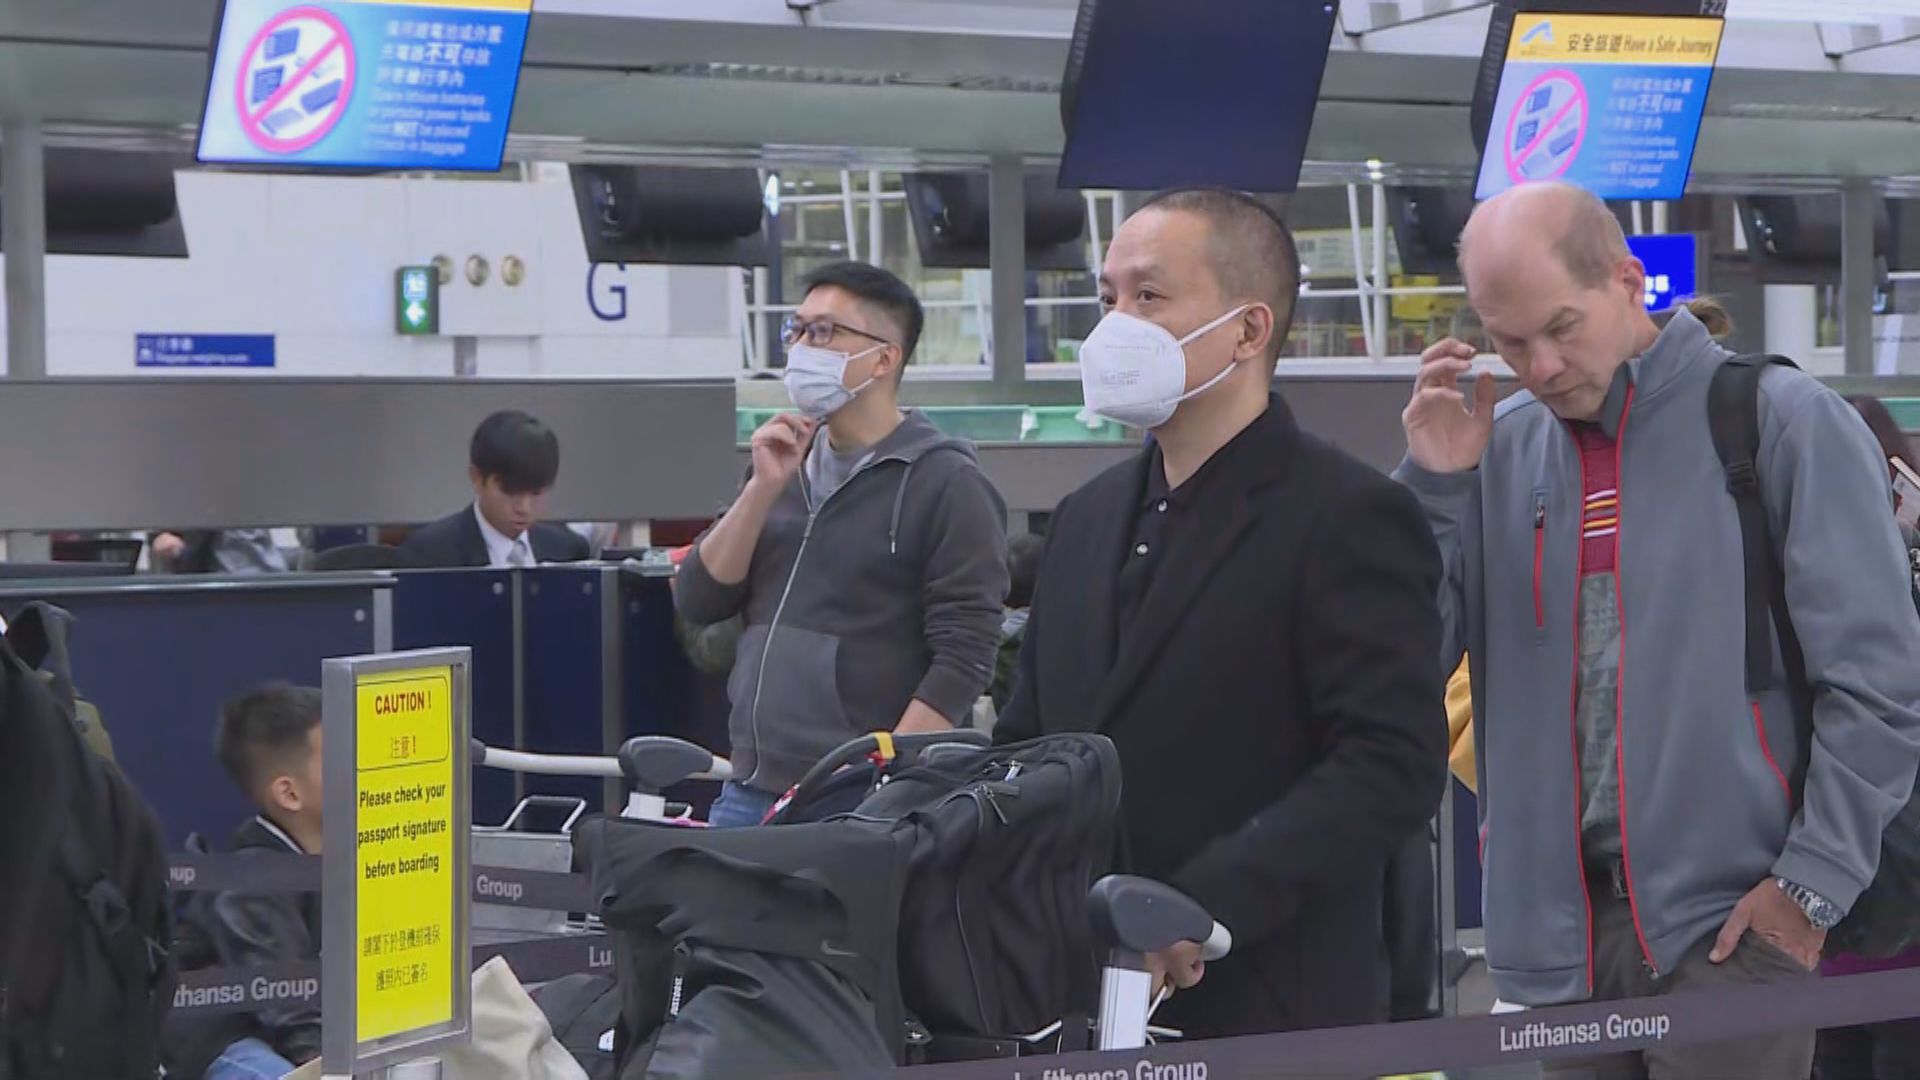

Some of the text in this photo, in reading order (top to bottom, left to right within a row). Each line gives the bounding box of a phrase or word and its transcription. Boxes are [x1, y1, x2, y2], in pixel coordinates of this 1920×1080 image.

[1624, 36, 1647, 51] Have
[1656, 34, 1677, 52] Safe
[1677, 36, 1714, 57] Journey
[586, 261, 627, 321] G
[375, 692, 425, 715] CAUTION
[359, 784, 446, 808] Please check your
[358, 818, 447, 849] passport signature
[365, 853, 440, 880] before boarding
[476, 874, 523, 900] Group
[588, 946, 614, 968] Lu
[250, 976, 319, 1001] Group
[1500, 1013, 1670, 1052] Lufthansa Group
[1135, 1059, 1208, 1080] Group
